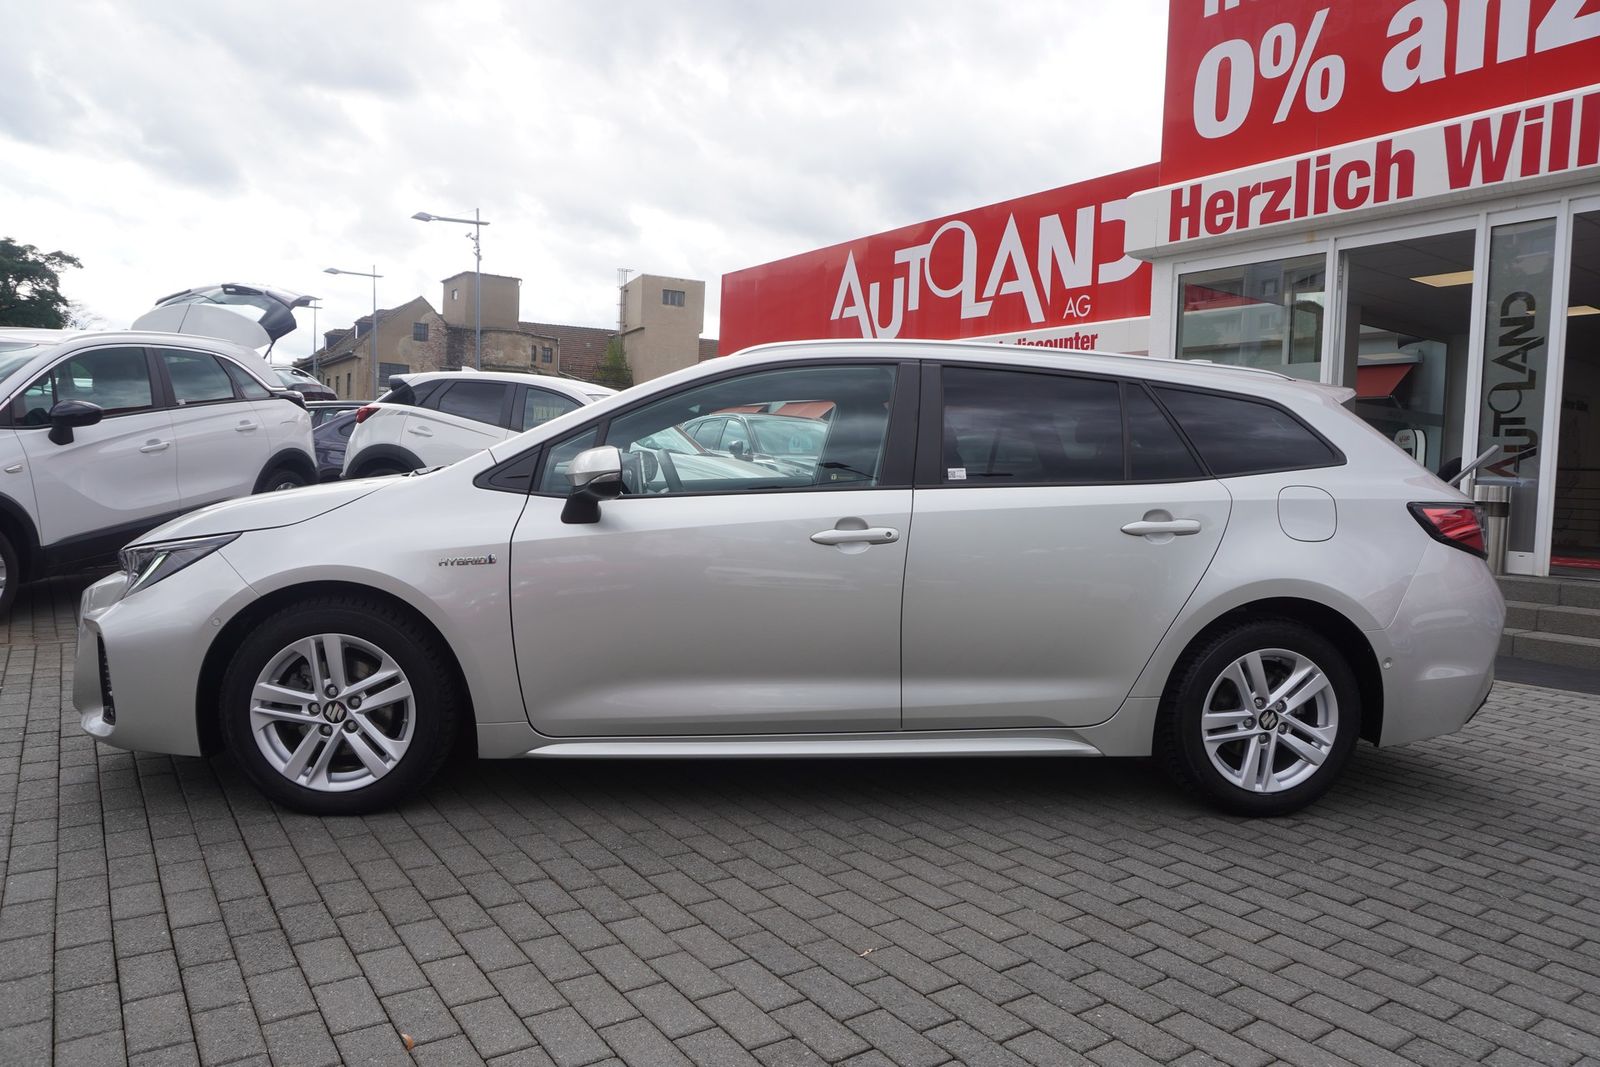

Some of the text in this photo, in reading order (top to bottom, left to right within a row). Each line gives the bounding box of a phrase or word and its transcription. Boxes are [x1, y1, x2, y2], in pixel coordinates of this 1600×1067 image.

[1193, 8, 1345, 139] 0%
[1168, 139, 1416, 243] Herzlich
[1063, 295, 1092, 319] AG
[1484, 291, 1545, 478] AUTOLAND
[438, 557, 487, 567] HYBRID
